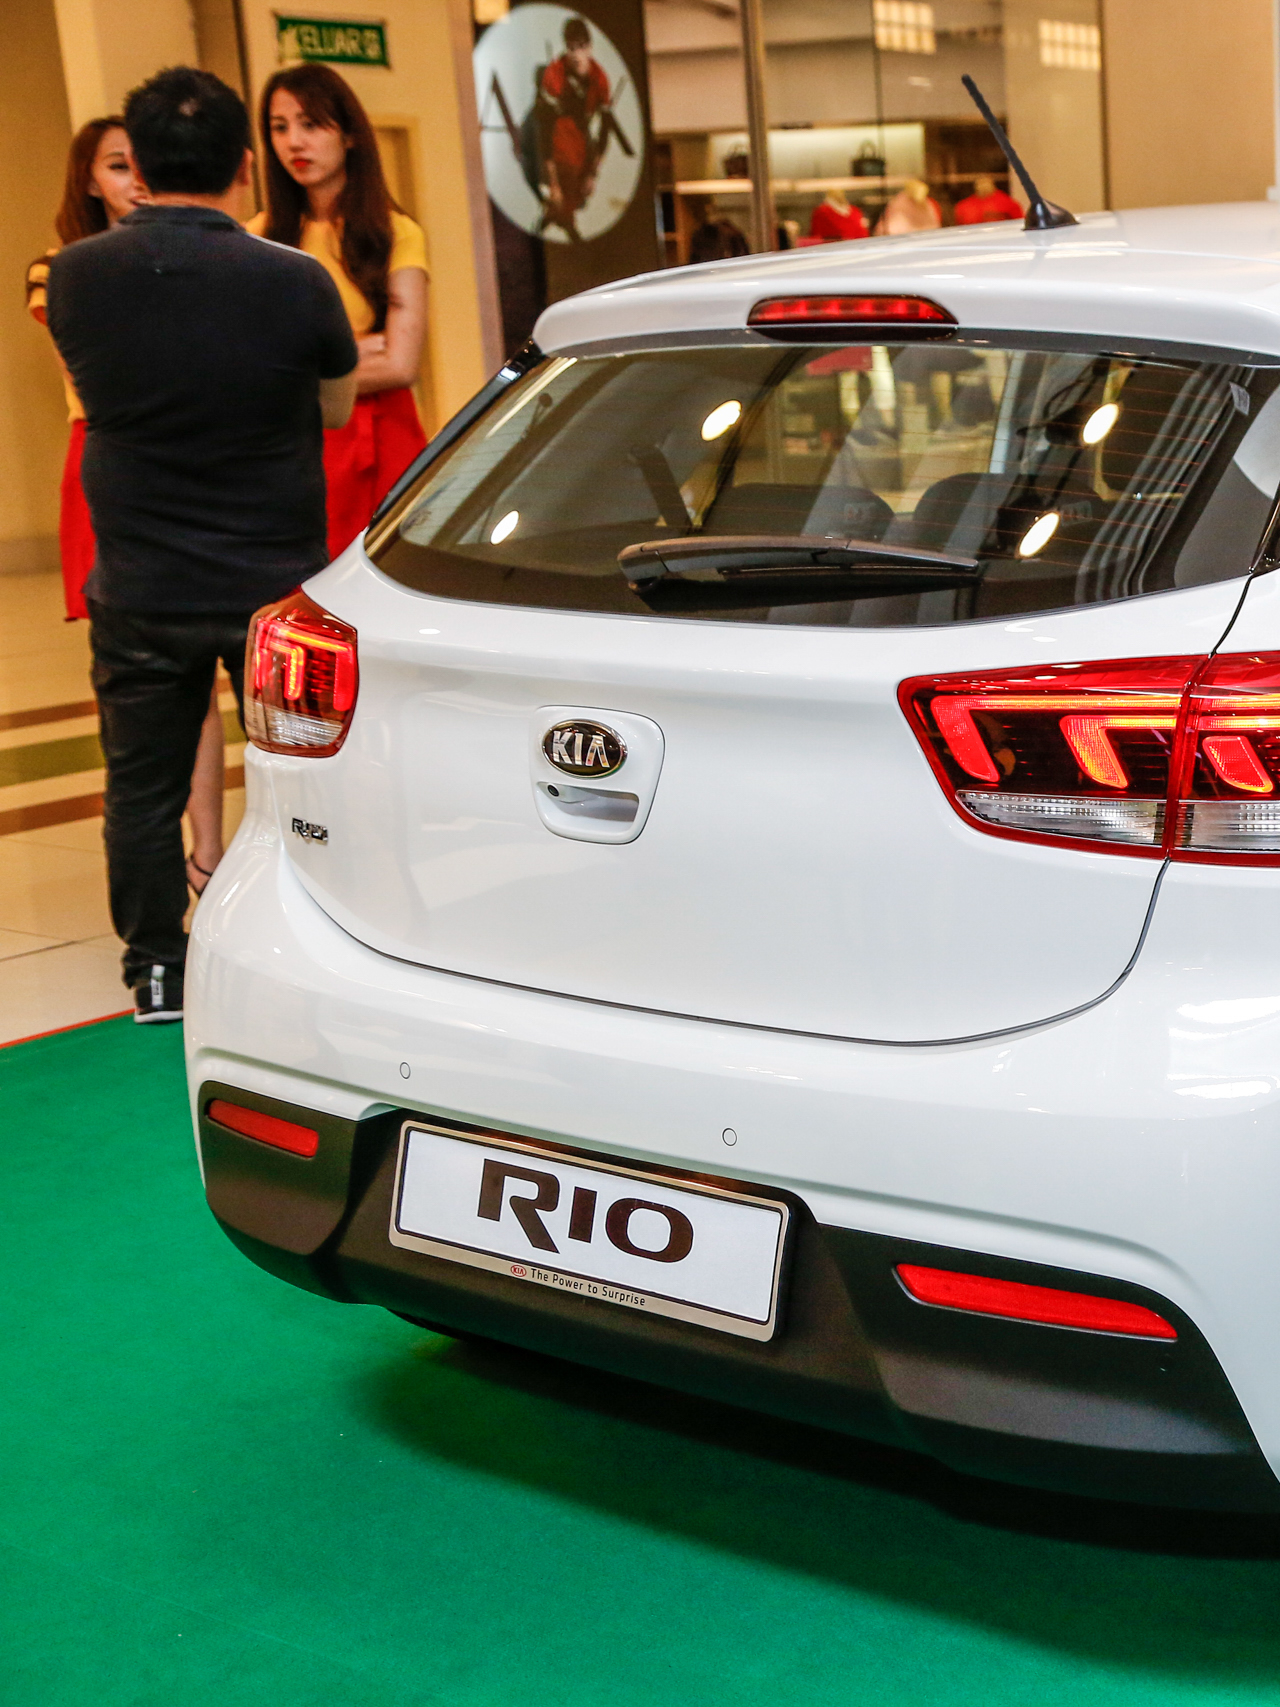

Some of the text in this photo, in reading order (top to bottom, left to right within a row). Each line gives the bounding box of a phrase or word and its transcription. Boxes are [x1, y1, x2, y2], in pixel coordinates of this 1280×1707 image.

[550, 728, 612, 770] KIA
[477, 1158, 694, 1263] RIO
[530, 1268, 549, 1282] The
[552, 1274, 584, 1290] Power
[587, 1283, 598, 1294] to
[601, 1286, 646, 1306] Surprise
